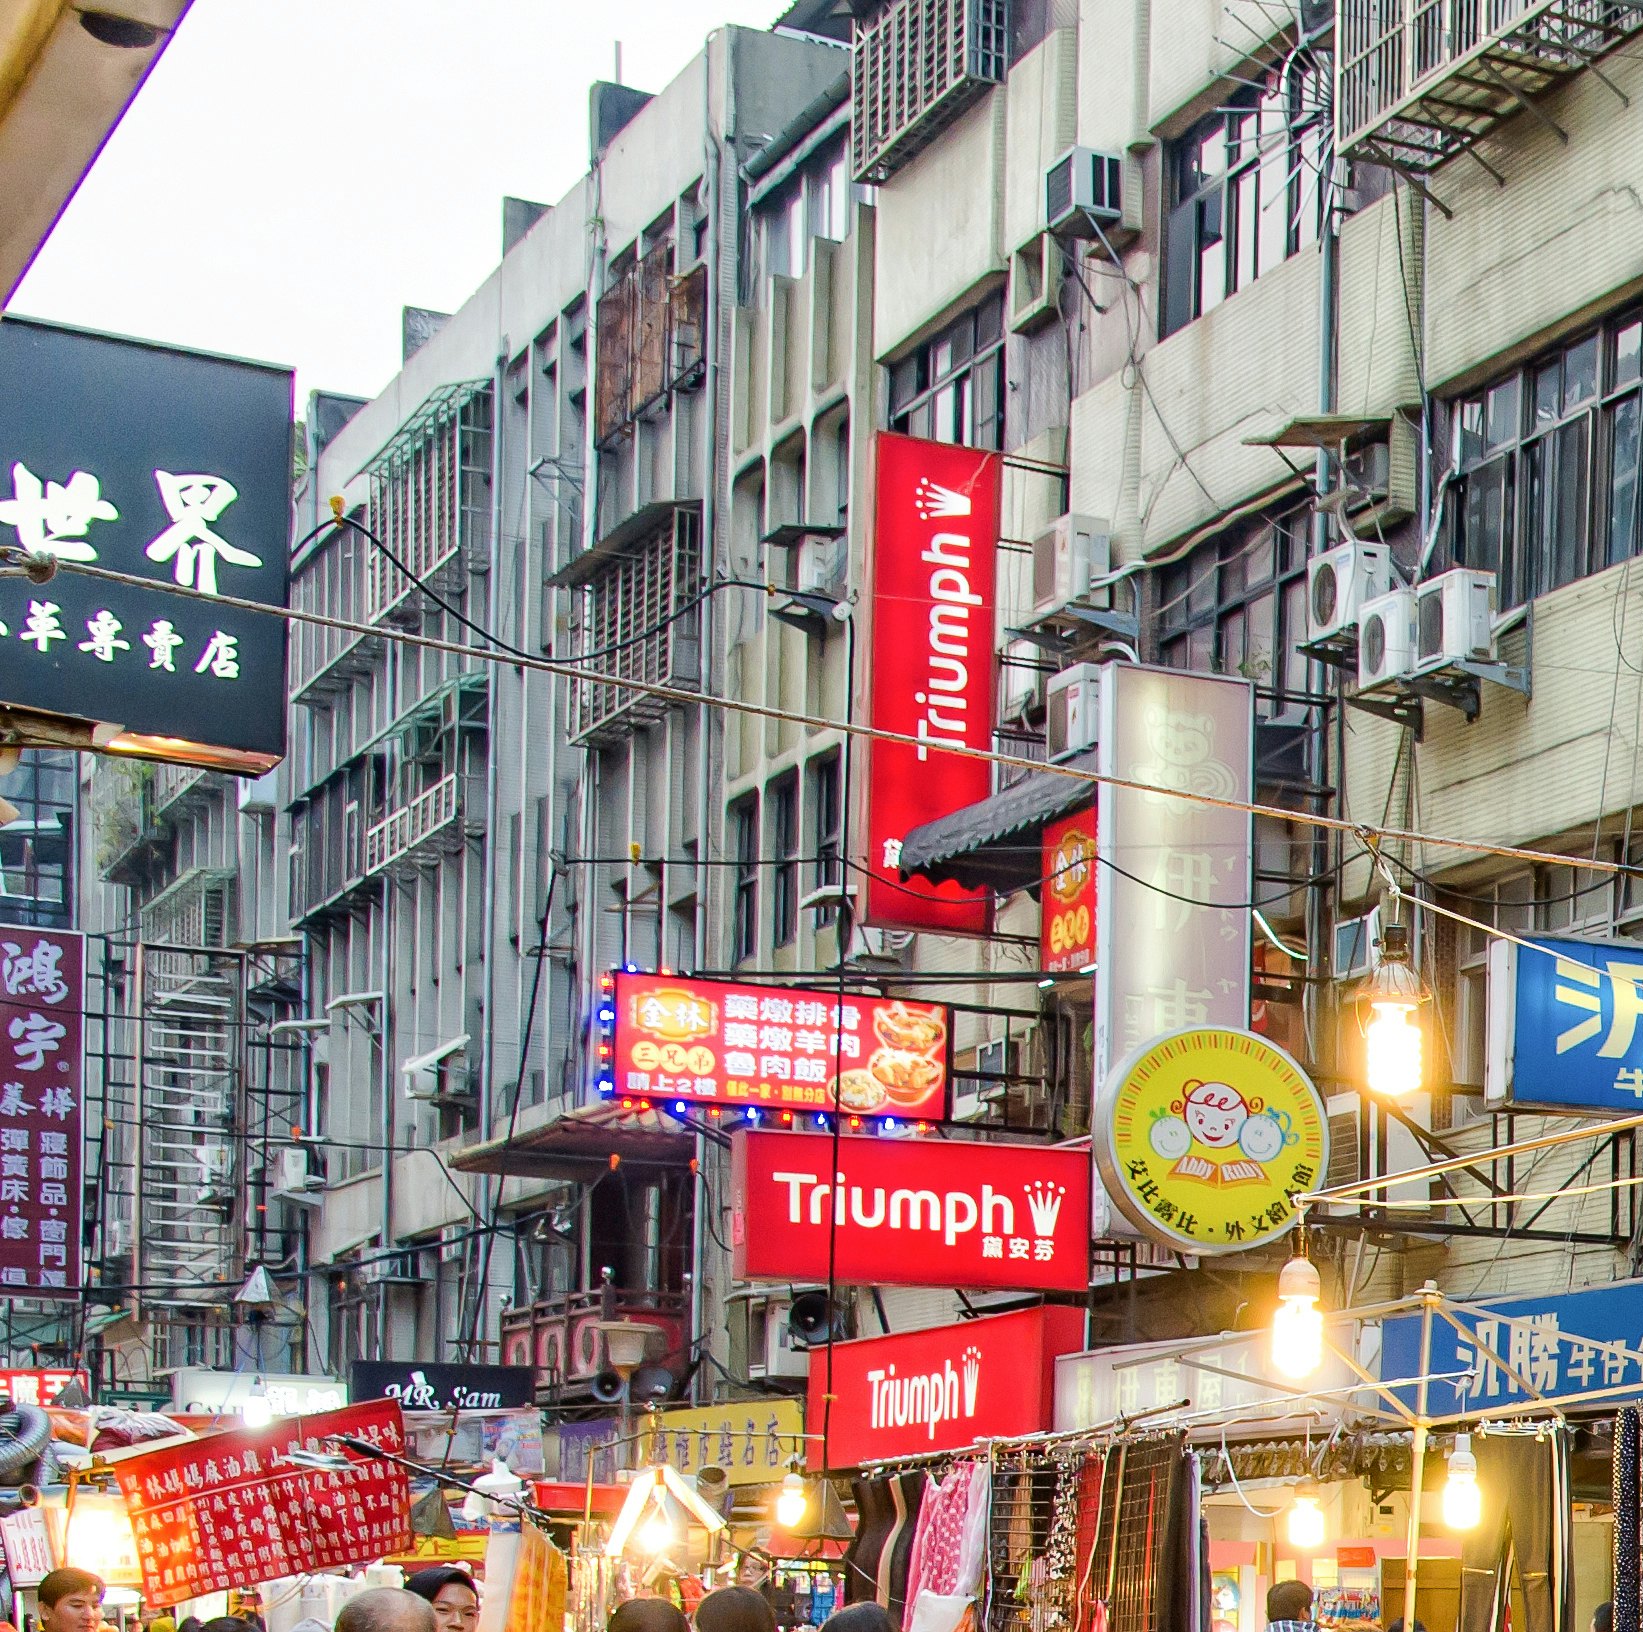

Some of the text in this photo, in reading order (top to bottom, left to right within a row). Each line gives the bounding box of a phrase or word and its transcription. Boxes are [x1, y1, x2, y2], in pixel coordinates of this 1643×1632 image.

[0, 462, 262, 593] 世界
[0, 602, 241, 679] 革專賣店
[916, 531, 983, 761] Triumph
[640, 995, 709, 1030] 金林
[724, 994, 861, 1029] 藥燉排骨
[724, 1022, 861, 1057] 藥燉羊肉
[724, 1052, 826, 1083] 魯肉飯
[773, 1173, 1015, 1245] Triumph
[981, 1236, 1056, 1261] 黛安芬
[868, 1366, 961, 1439] Triumph
